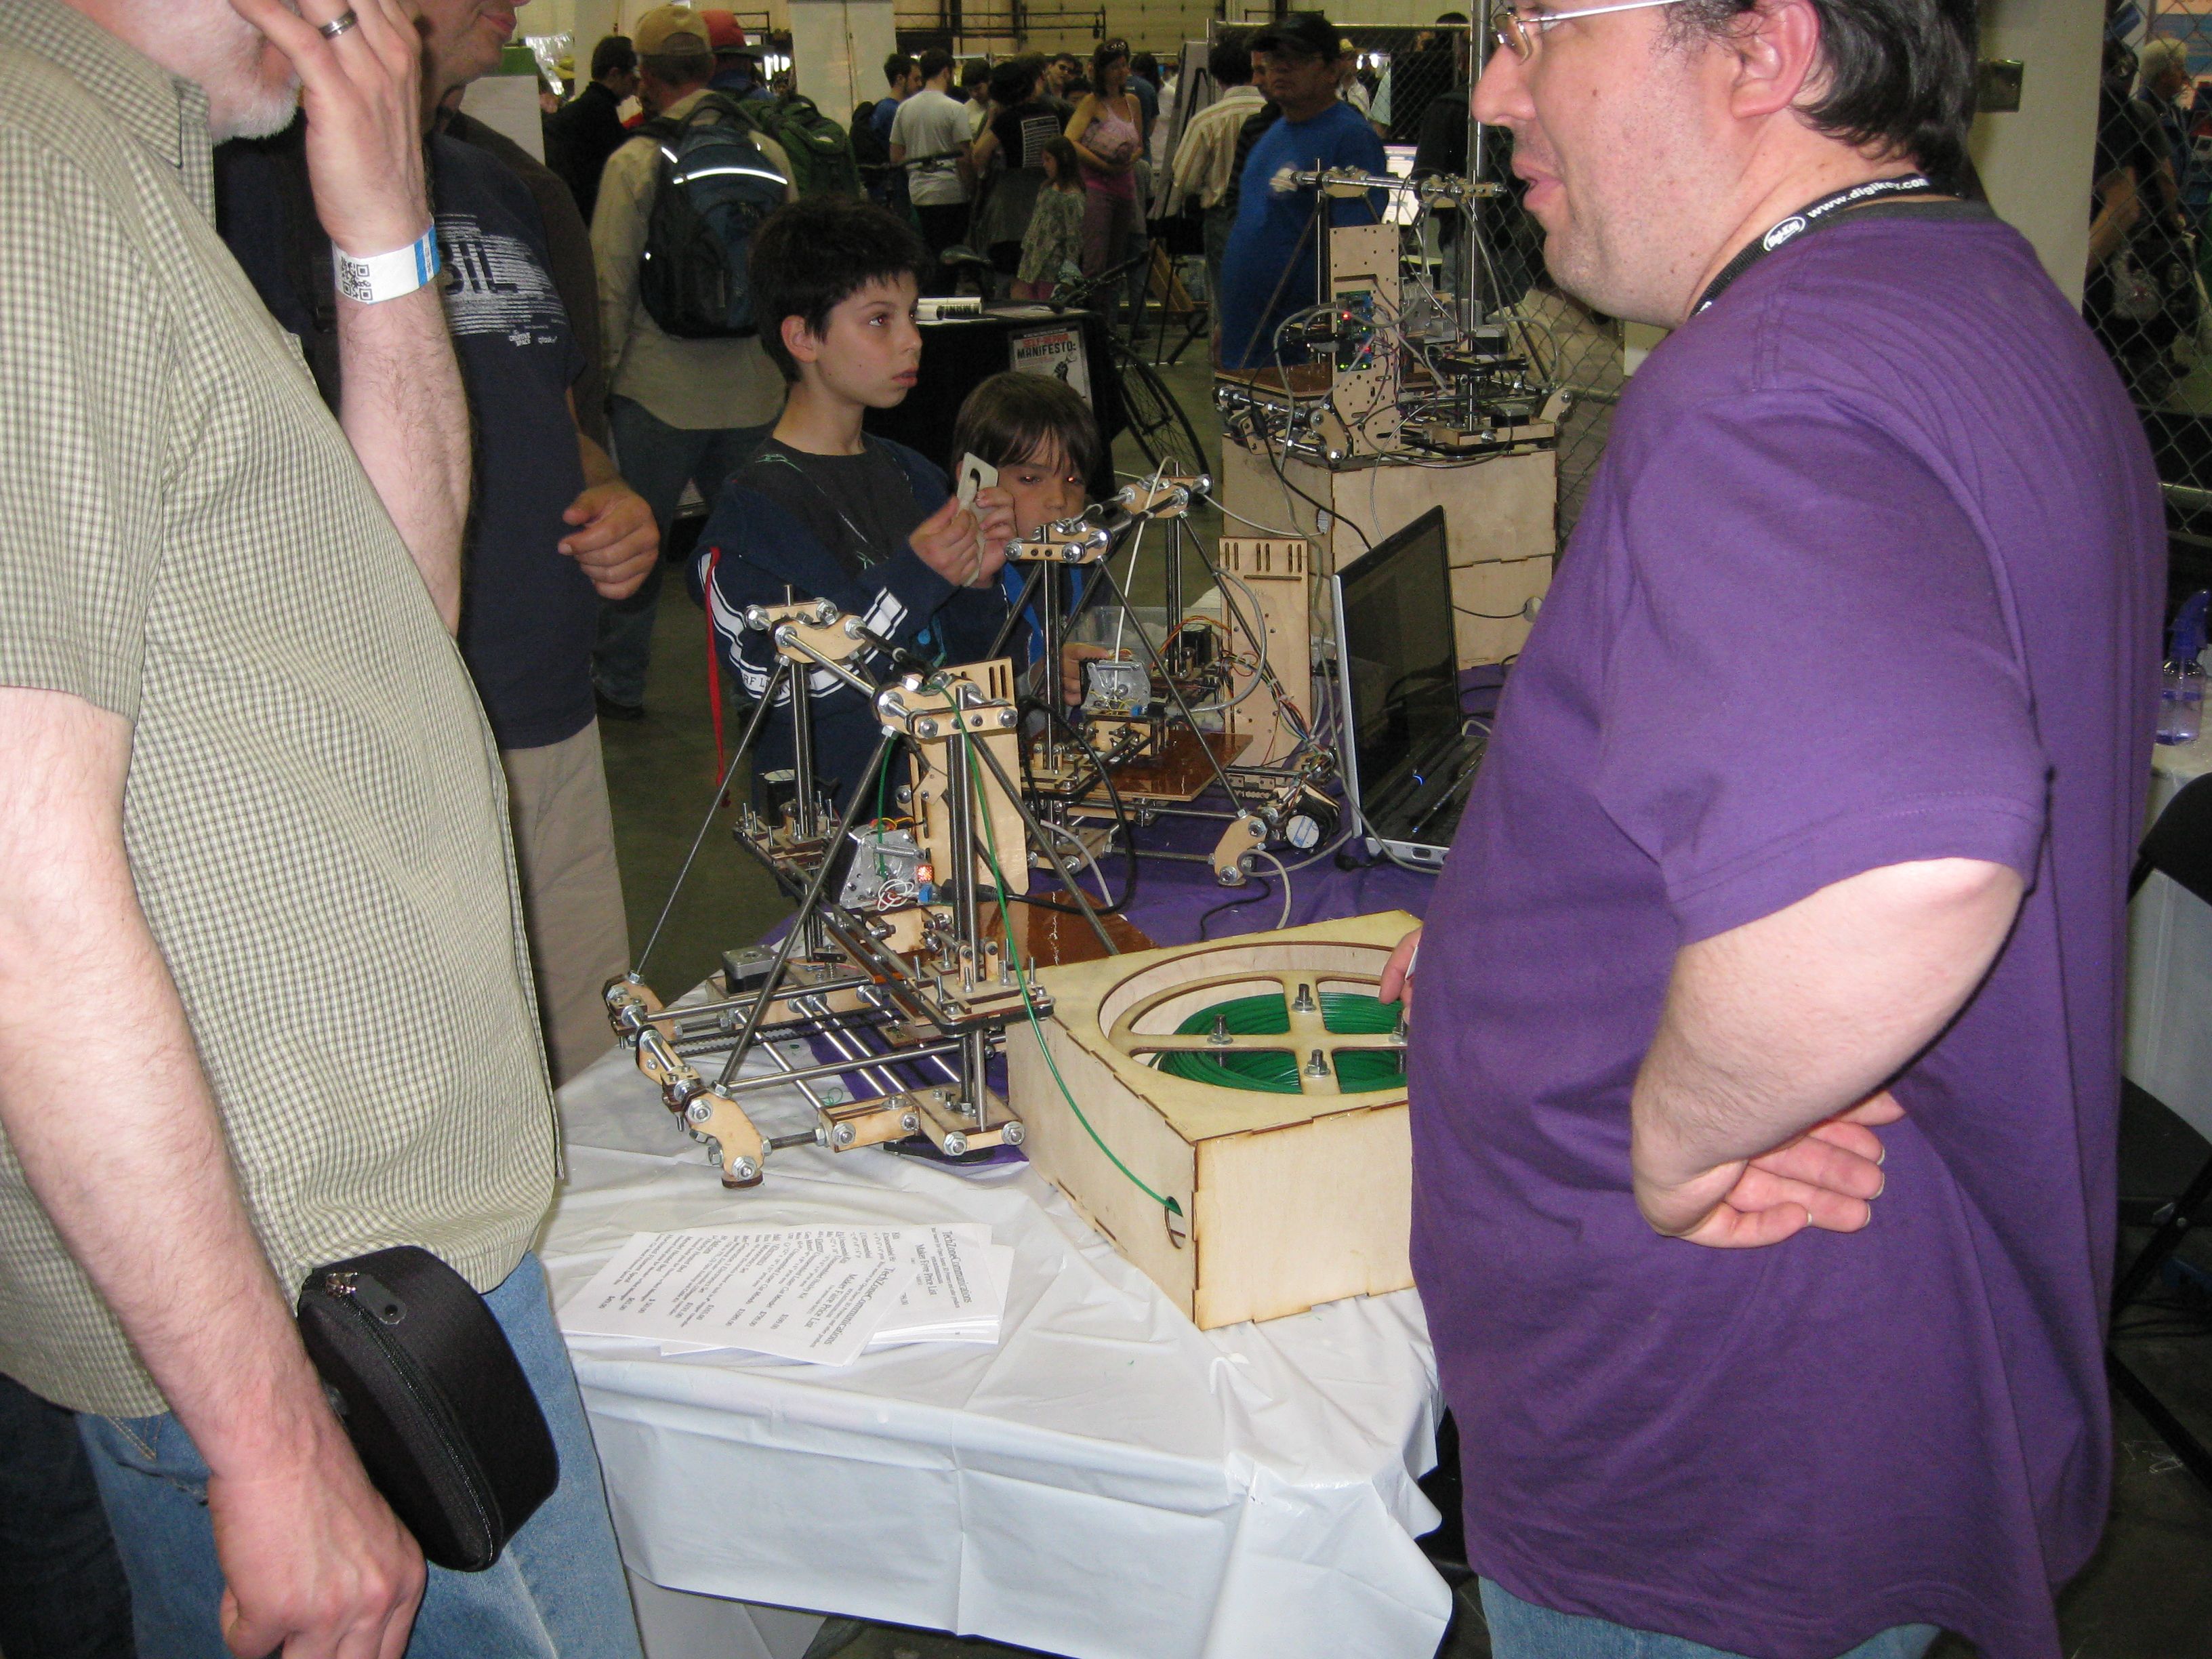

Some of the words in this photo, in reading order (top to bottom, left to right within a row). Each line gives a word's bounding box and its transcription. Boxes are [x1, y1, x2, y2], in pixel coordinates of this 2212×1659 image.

[915, 1244, 927, 1259] Maker
[920, 1260, 932, 1272] Faire
[942, 1231, 972, 1303] TechZoneCommunications
[838, 1273, 858, 1290] Maker
[924, 1273, 936, 1285] Price
[825, 1290, 844, 1303] Faire
[928, 1286, 938, 1295] List
[813, 1303, 832, 1317] Price
[823, 1267, 896, 1345] TechZoneCommunications
[804, 1317, 821, 1328] List
